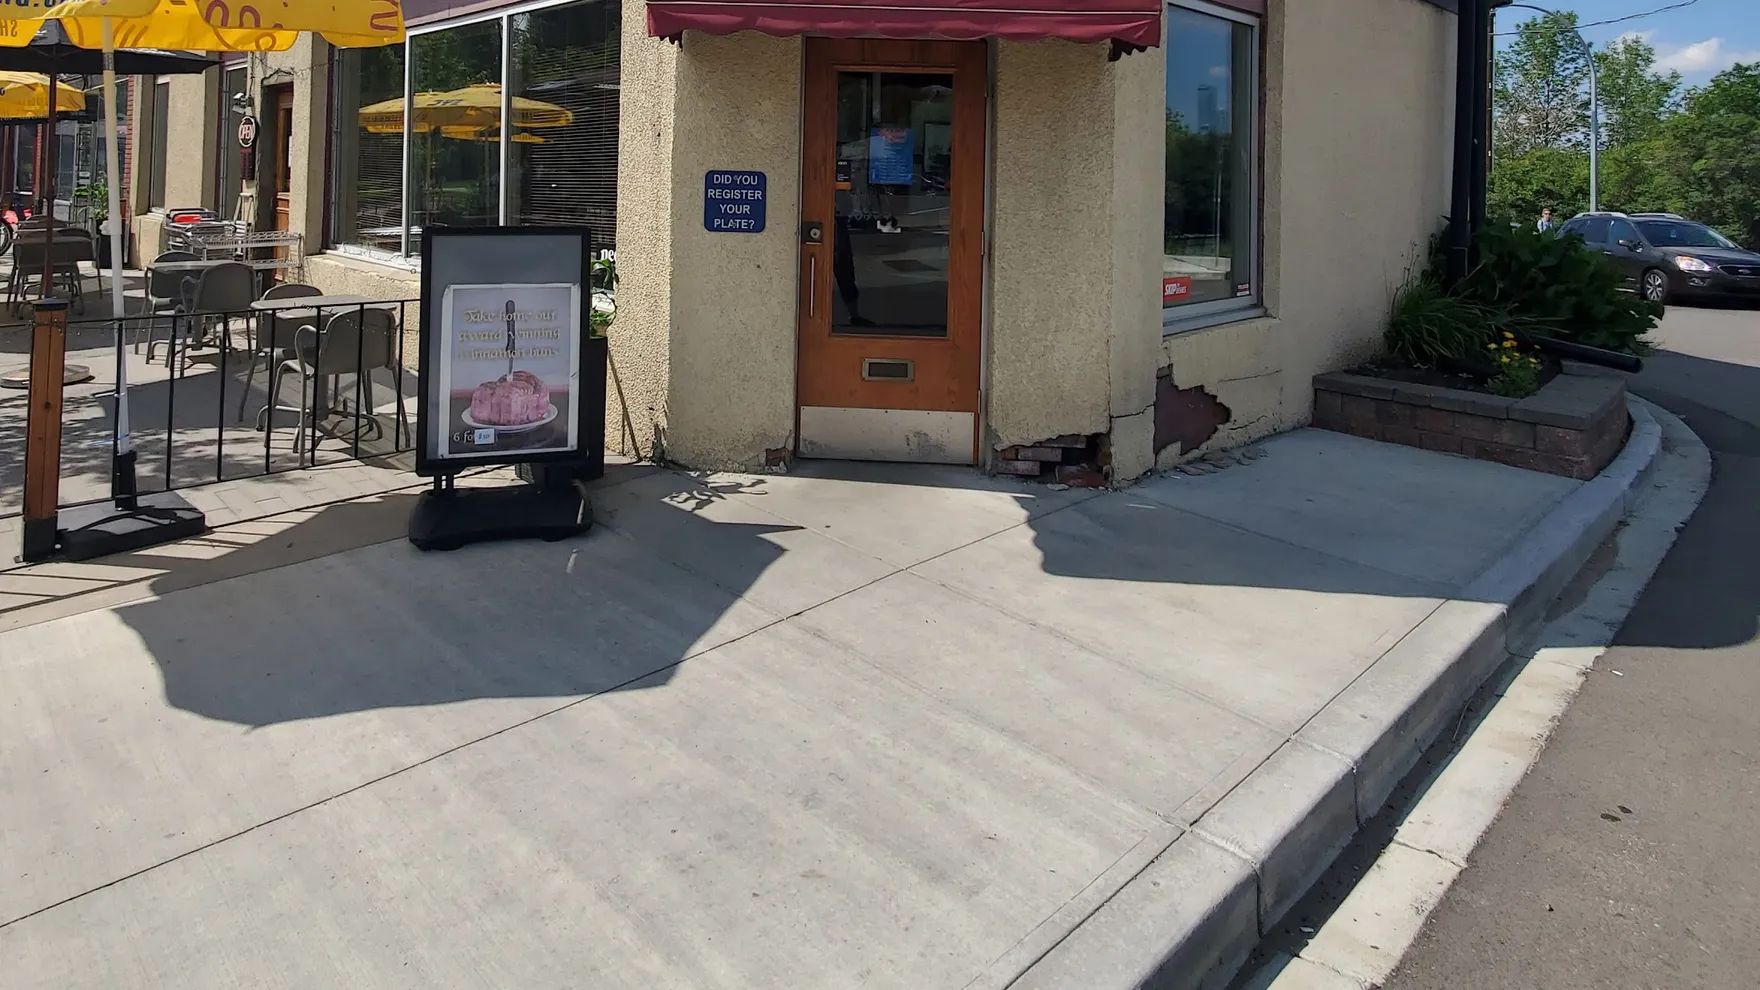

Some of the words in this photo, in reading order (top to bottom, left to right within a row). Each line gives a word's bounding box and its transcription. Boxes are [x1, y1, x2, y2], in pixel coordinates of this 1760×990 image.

[713, 174, 732, 184] DID
[735, 175, 758, 185] YOU
[707, 188, 763, 200] REGISTER
[719, 203, 751, 215] YOUR
[713, 218, 755, 230] PLATE?
[464, 309, 494, 322] Take
[499, 309, 531, 322] home
[536, 311, 556, 320] our
[453, 432, 460, 442] 6
